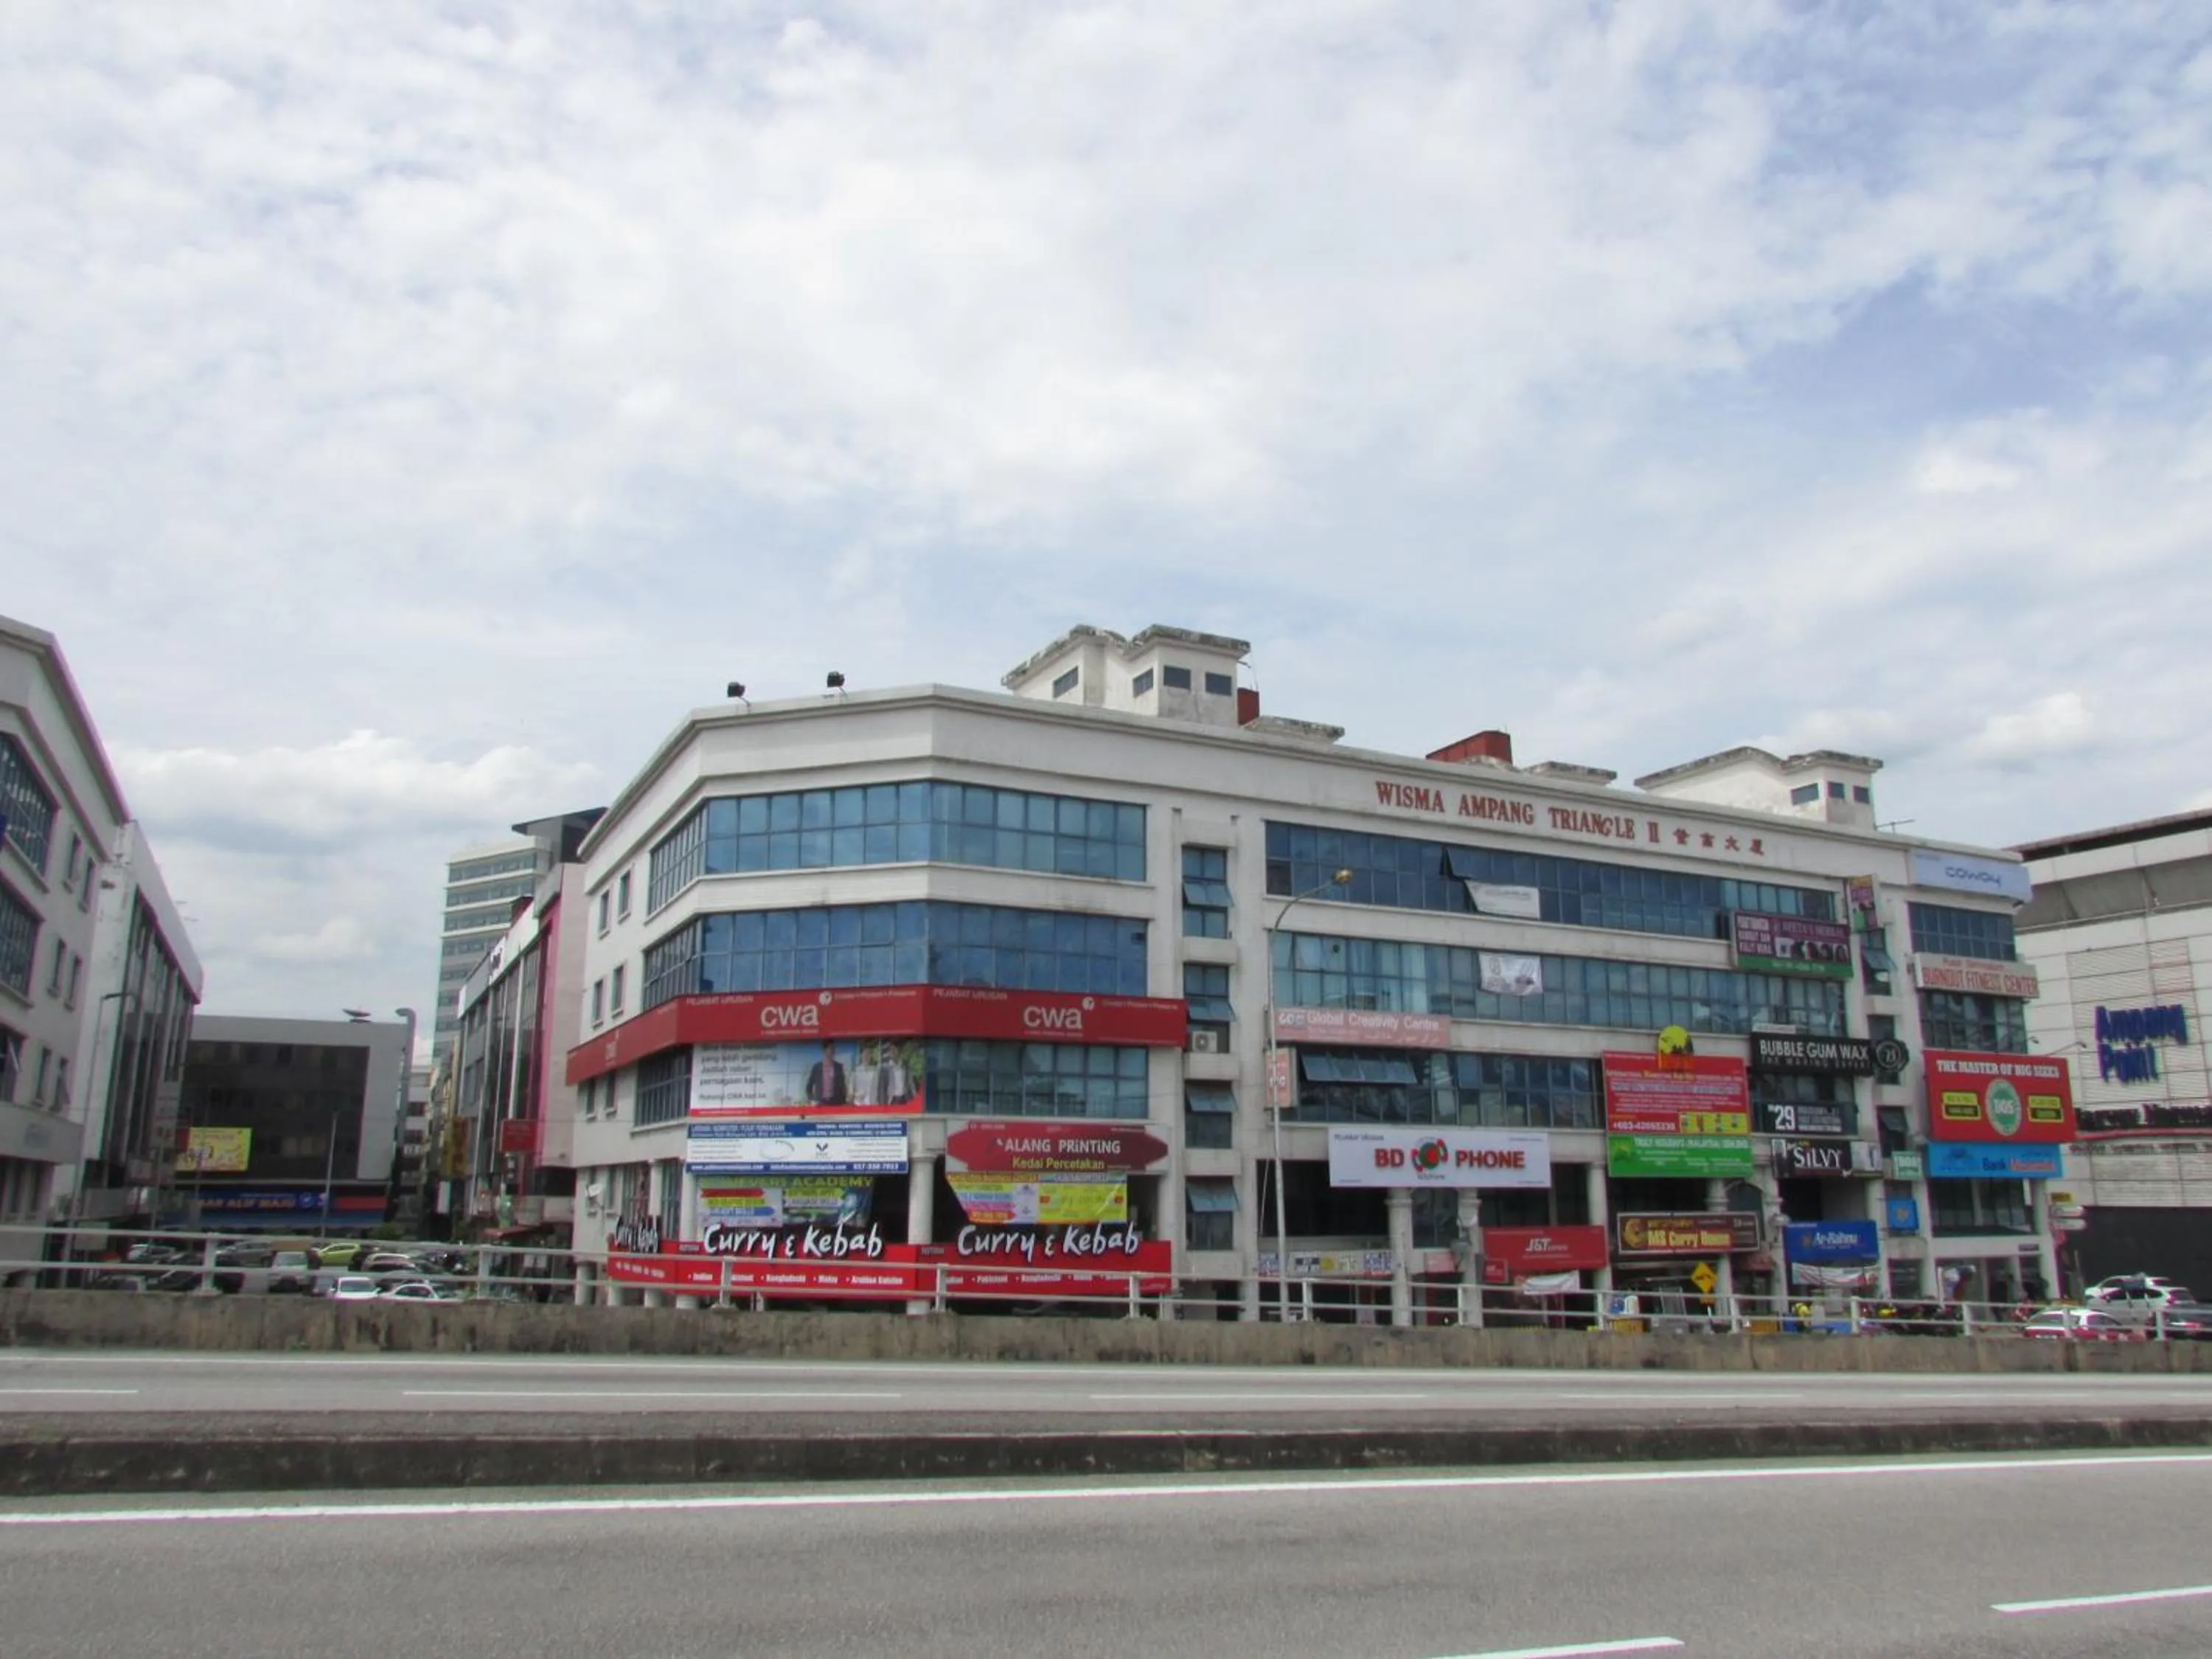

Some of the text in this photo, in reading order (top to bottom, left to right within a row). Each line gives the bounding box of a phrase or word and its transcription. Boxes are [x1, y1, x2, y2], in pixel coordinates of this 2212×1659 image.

[1375, 781, 1660, 843] WISMA AMPANG TRIANGLE II
[2004, 973, 2037, 995] CENTER
[761, 1004, 818, 1027] cwa
[1023, 1006, 1082, 1029] cwa
[1307, 1011, 1343, 1026] Global
[1349, 1013, 1398, 1032] Creativity
[1404, 1016, 1439, 1030] Centre
[1760, 1039, 1869, 1060] BUBBLE GUM WAX
[1935, 1060, 1957, 1073] THE
[1958, 1061, 1999, 1074] MASTER
[1012, 1157, 1105, 1170] Kedai Percetakan
[1374, 1148, 1525, 1172] BD PHONE
[793, 1176, 874, 1187] ACADEMY
[703, 1224, 776, 1259] Curry
[803, 1220, 883, 1258] Kebab
[958, 1225, 1036, 1262] Curry
[1062, 1221, 1138, 1256] Kebab
[1525, 1238, 1551, 1251] J&T
[1669, 1230, 1698, 1248] Curry
[1813, 1231, 1859, 1245] Ar-Rahnu
